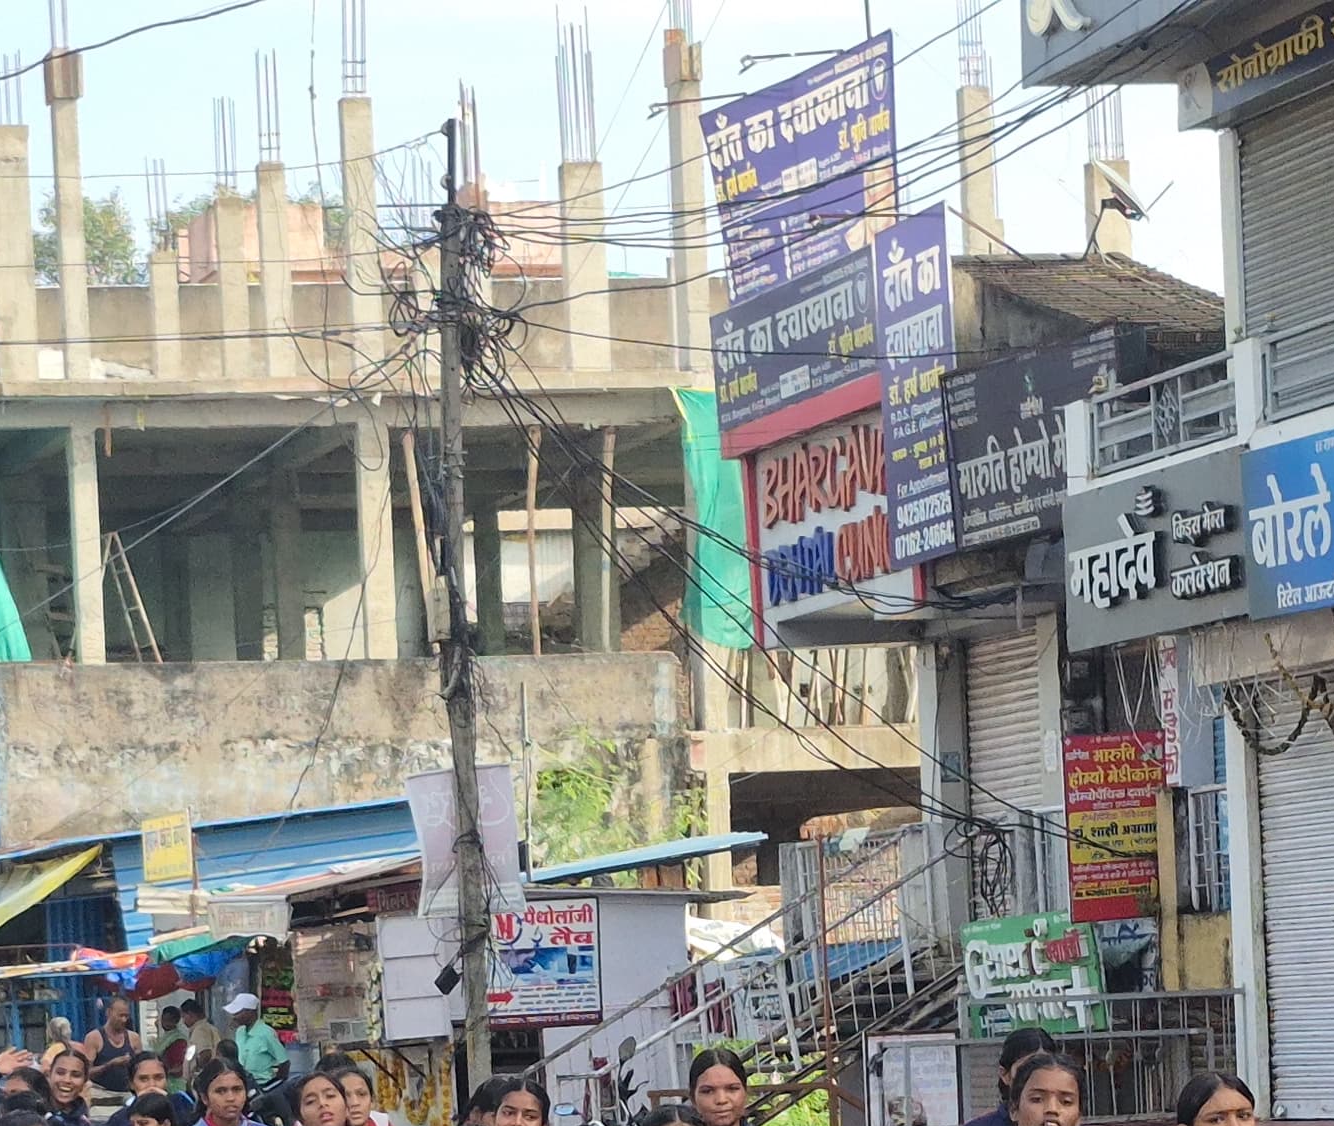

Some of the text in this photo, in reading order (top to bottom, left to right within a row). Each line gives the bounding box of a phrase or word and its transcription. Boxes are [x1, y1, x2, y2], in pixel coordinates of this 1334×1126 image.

[745, 110, 775, 153] का
[915, 245, 941, 295] का
[748, 316, 774, 357] का
[1249, 463, 1332, 568] बोरले
[1068, 513, 1157, 609] महादेव
